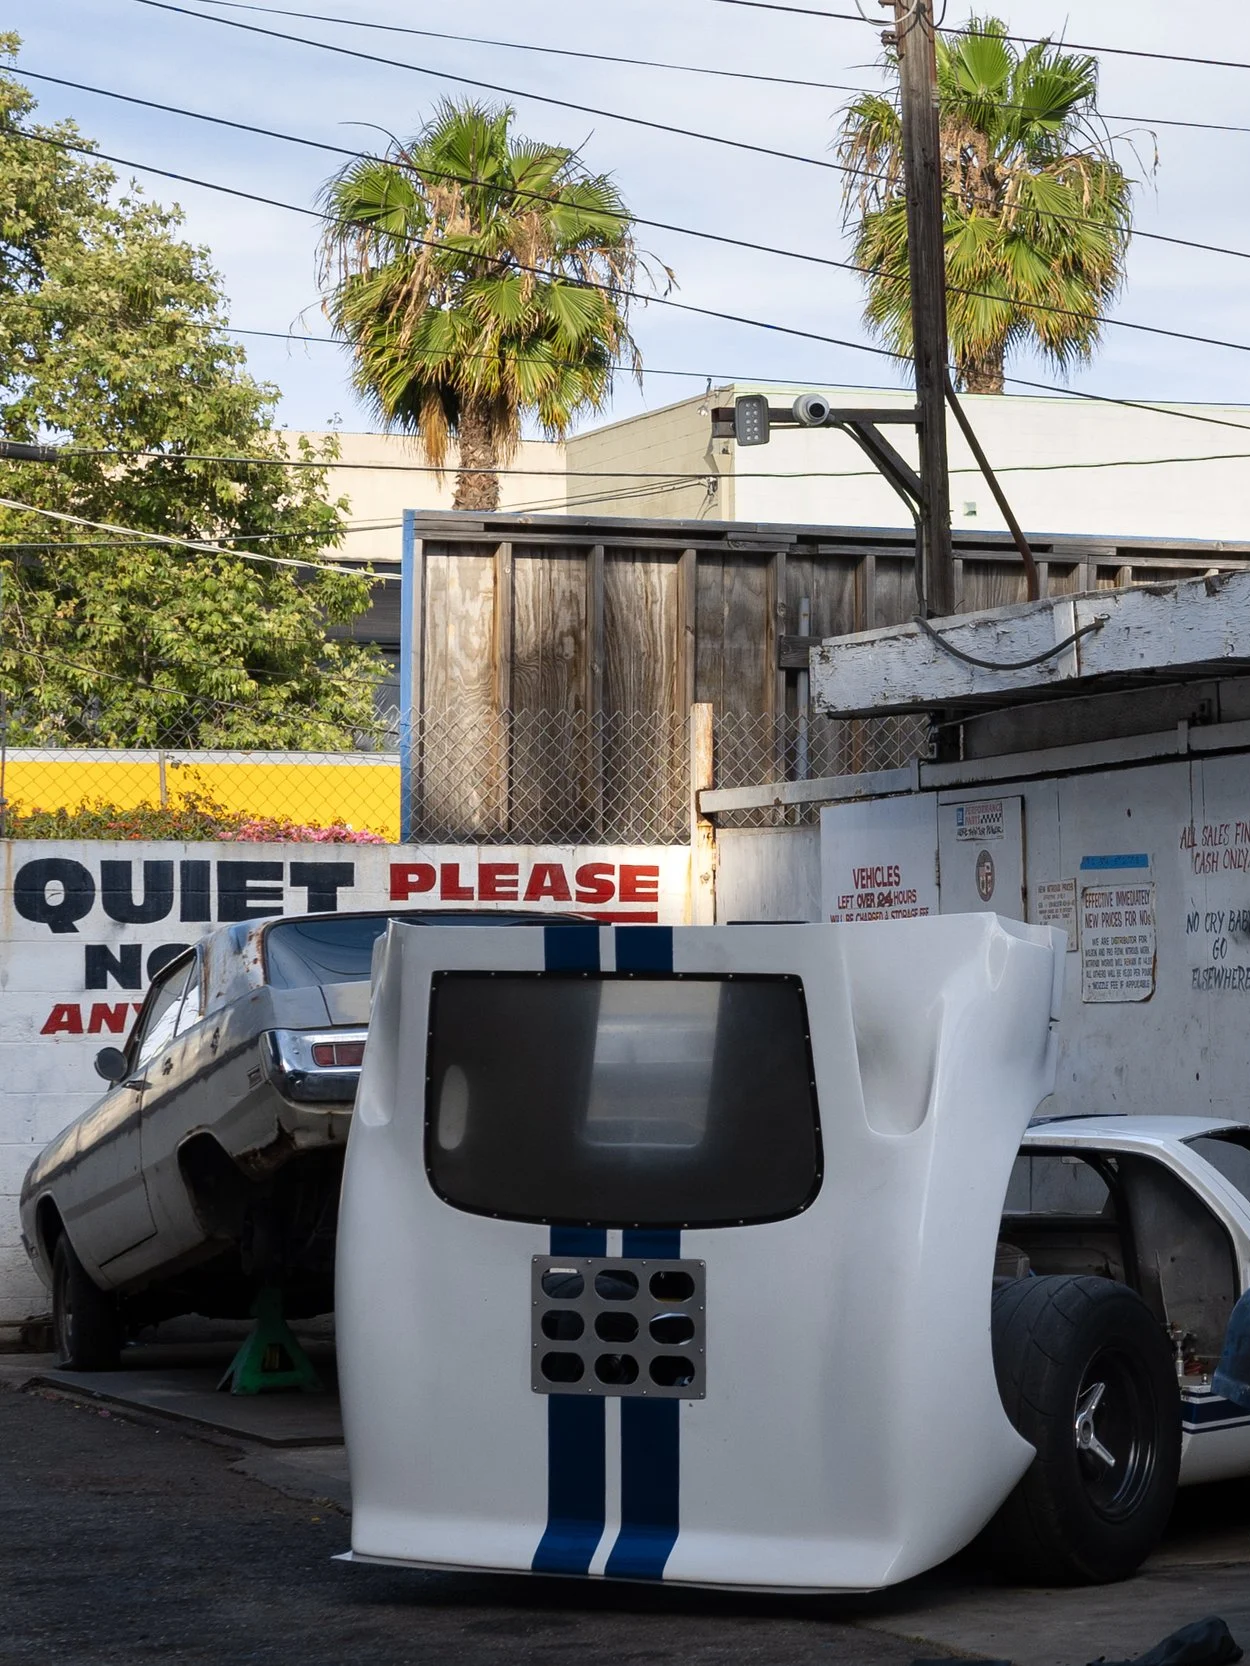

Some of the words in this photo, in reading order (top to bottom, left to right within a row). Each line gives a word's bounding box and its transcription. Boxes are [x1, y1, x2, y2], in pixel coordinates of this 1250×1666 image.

[965, 803, 1002, 815] PERFORMANCE
[1180, 826, 1197, 849] ALL
[1202, 824, 1230, 847] SALES
[1194, 851, 1219, 875] CASH
[852, 865, 901, 890] VEHICLES
[13, 857, 355, 934] QUIET
[389, 863, 660, 904] PLEASE
[837, 895, 854, 910] LEFT
[856, 892, 876, 909] OVER
[893, 889, 917, 905] HOURS
[1085, 892, 1113, 909] EFFECTIVE
[1116, 889, 1151, 907] IMMEDIATELY
[1085, 912, 1099, 929] NEW
[1101, 911, 1122, 928] PRICES
[1125, 910, 1137, 927] FOR
[1186, 911, 1200, 935] NO
[1204, 911, 1225, 934] CRY
[1100, 937, 1109, 946] ARE
[1111, 935, 1137, 946] DISTRIBUTOR
[1212, 937, 1227, 960] GO
